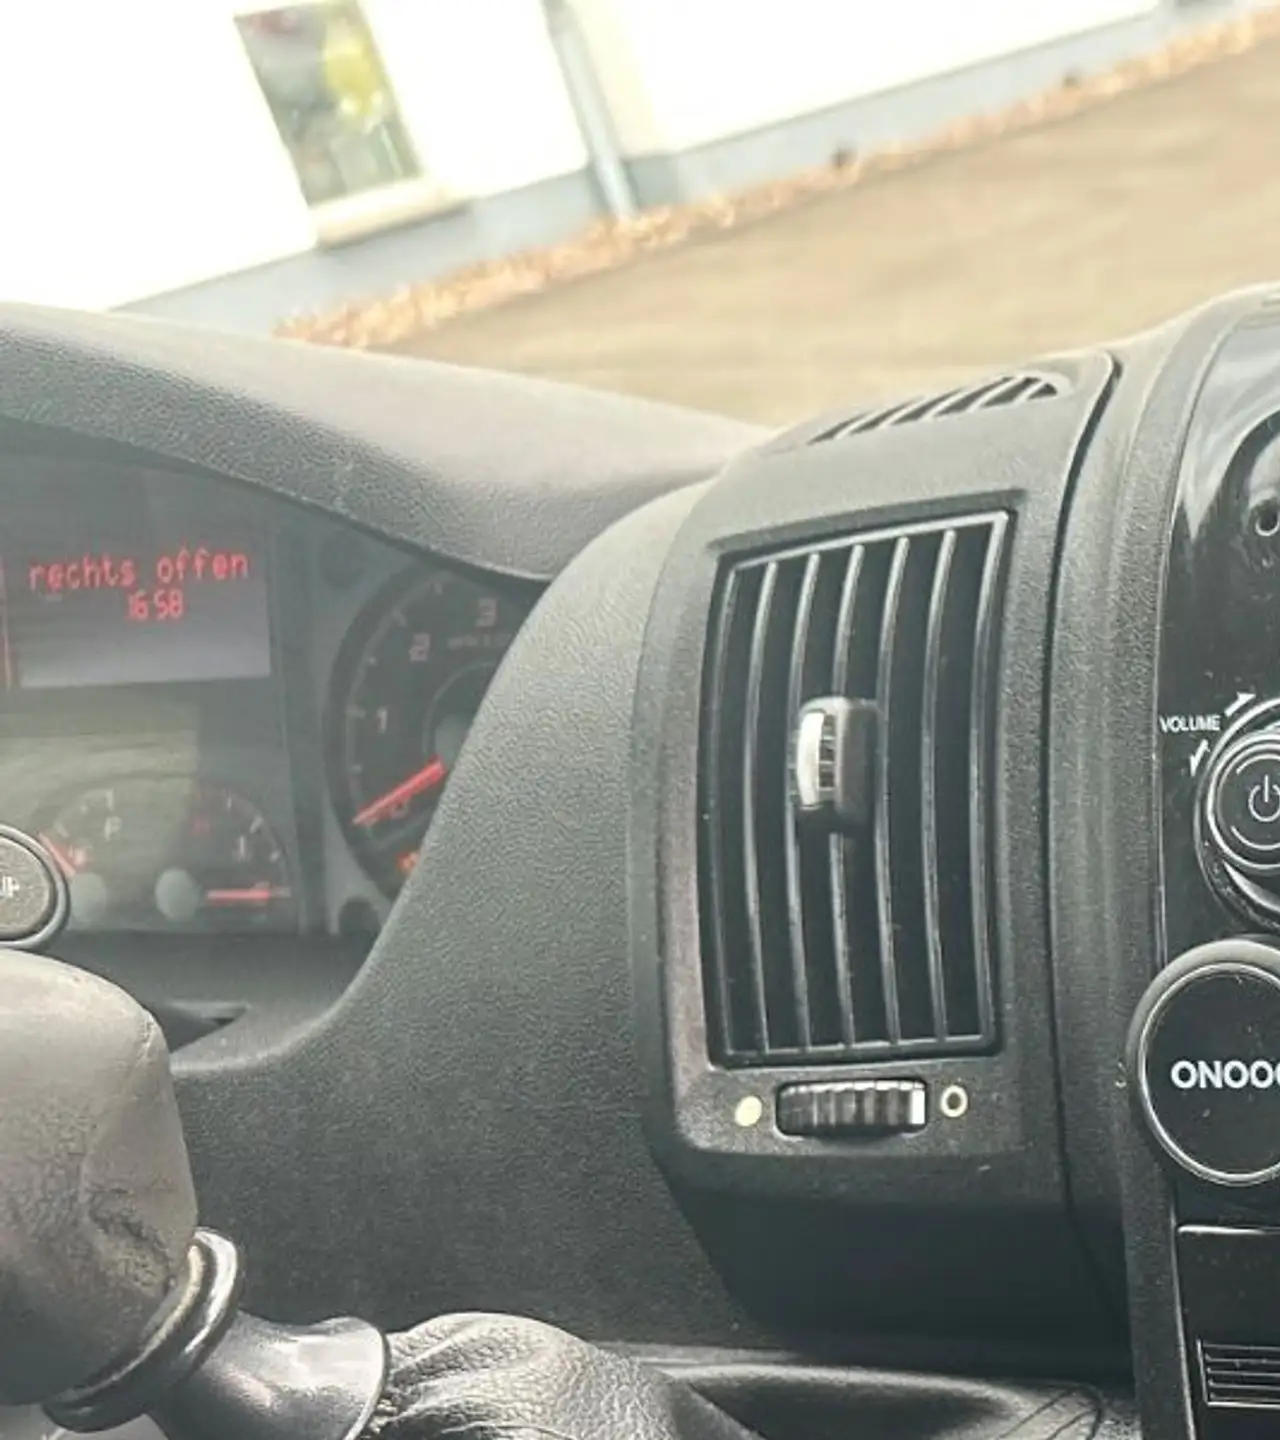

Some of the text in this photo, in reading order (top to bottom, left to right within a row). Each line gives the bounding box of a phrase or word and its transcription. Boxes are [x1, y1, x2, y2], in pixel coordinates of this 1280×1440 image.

[29, 543, 249, 592] rechts offen
[1160, 714, 1221, 733] VOLUME
